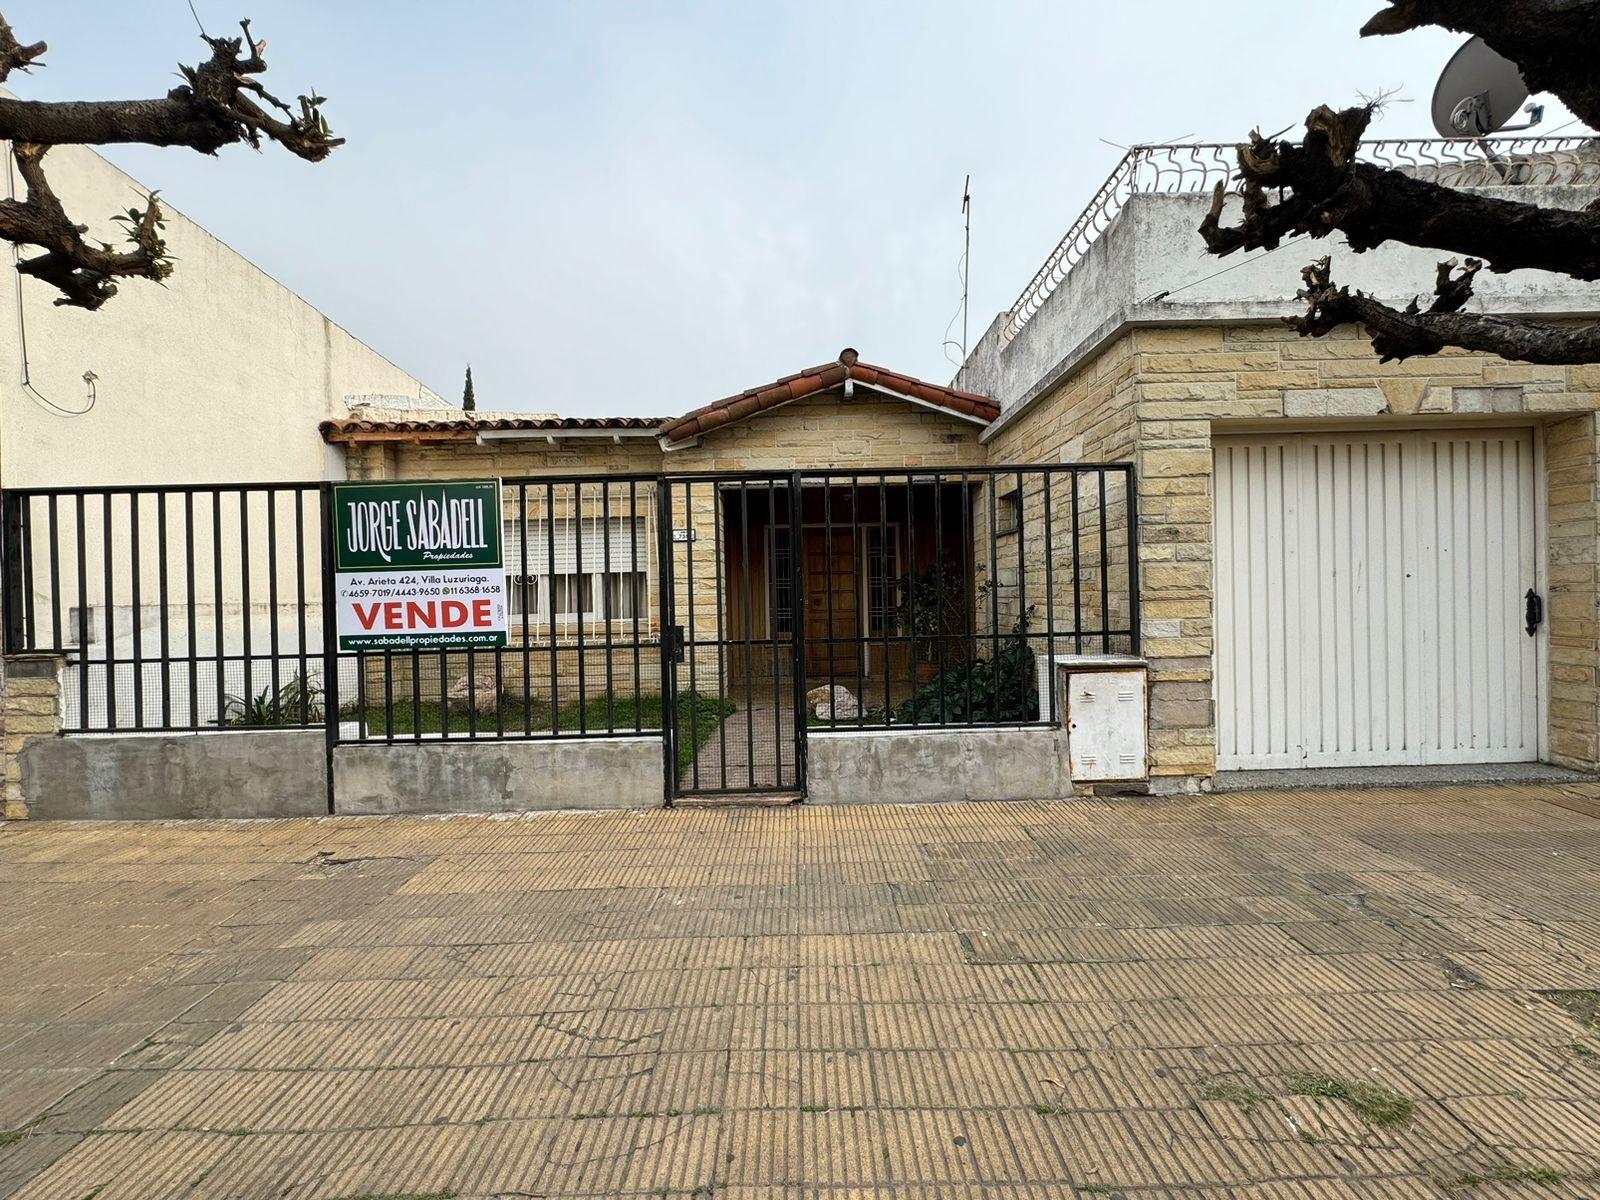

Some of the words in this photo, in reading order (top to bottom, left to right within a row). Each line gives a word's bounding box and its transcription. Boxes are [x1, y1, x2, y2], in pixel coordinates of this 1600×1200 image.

[347, 500, 402, 563] JORGE
[406, 488, 488, 551] SABADELL
[422, 551, 474, 561] Propiedades
[350, 577, 365, 586] Av.
[368, 576, 396, 586] Arieta
[398, 576, 419, 586] 424,
[421, 575, 441, 585] Villa
[443, 574, 489, 585] Luzuriaga.
[348, 587, 440, 597] 4659-7019/4443-9650
[351, 599, 492, 631] VENDE
[348, 635, 498, 646] www.sabadellpropiedades.com.ar
